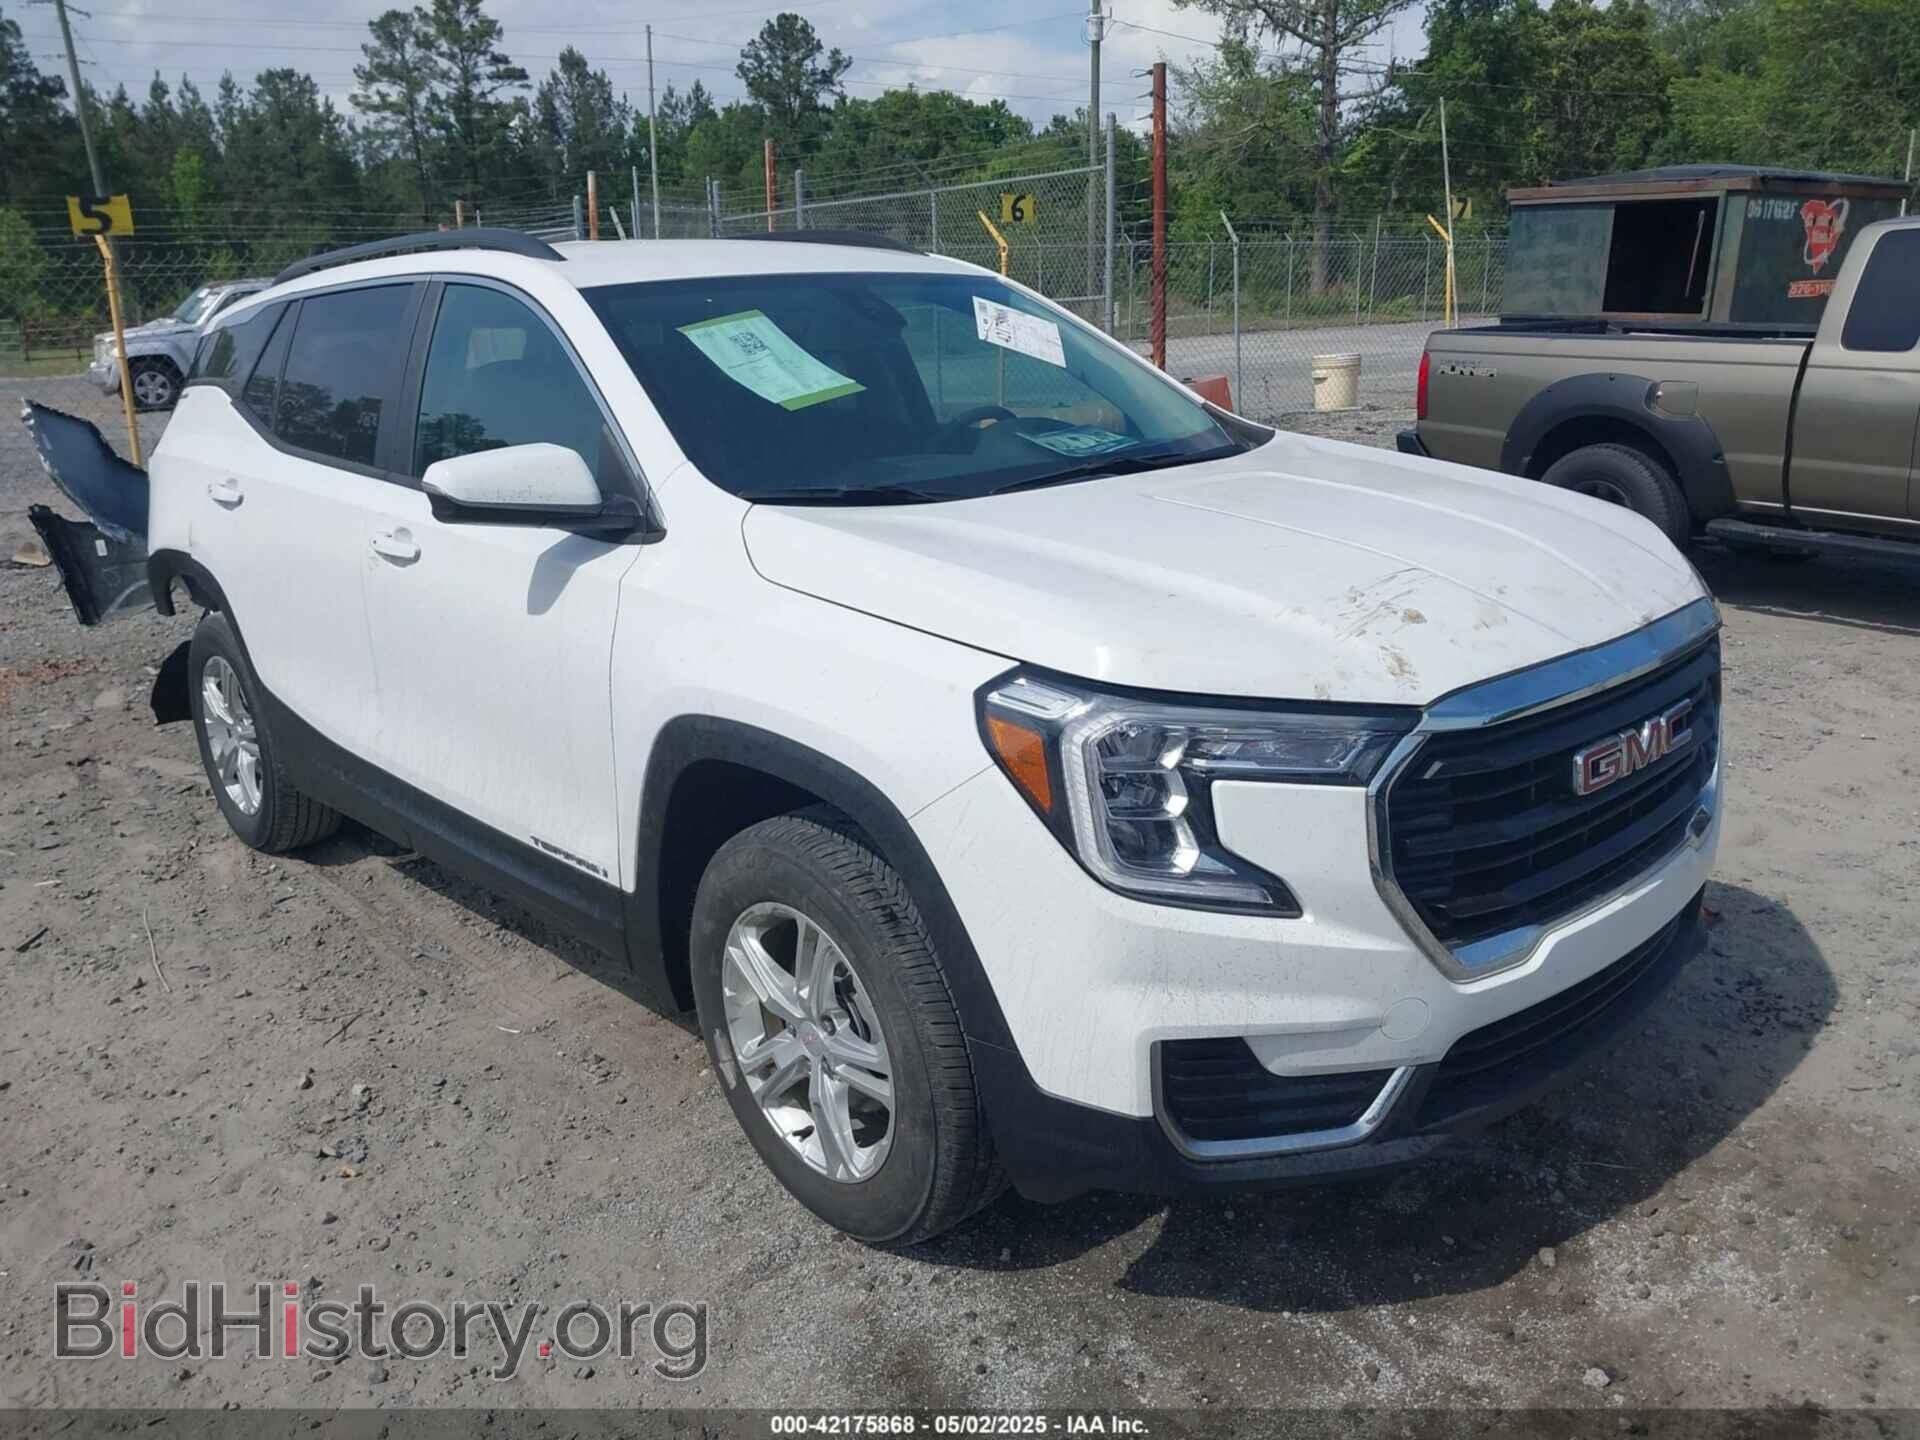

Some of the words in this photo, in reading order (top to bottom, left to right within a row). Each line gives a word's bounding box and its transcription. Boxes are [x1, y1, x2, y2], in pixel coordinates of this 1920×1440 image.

[80, 196, 113, 236] 5
[1011, 193, 1025, 222] 6
[1456, 197, 1468, 218] 7
[1573, 699, 1695, 795] GMC
